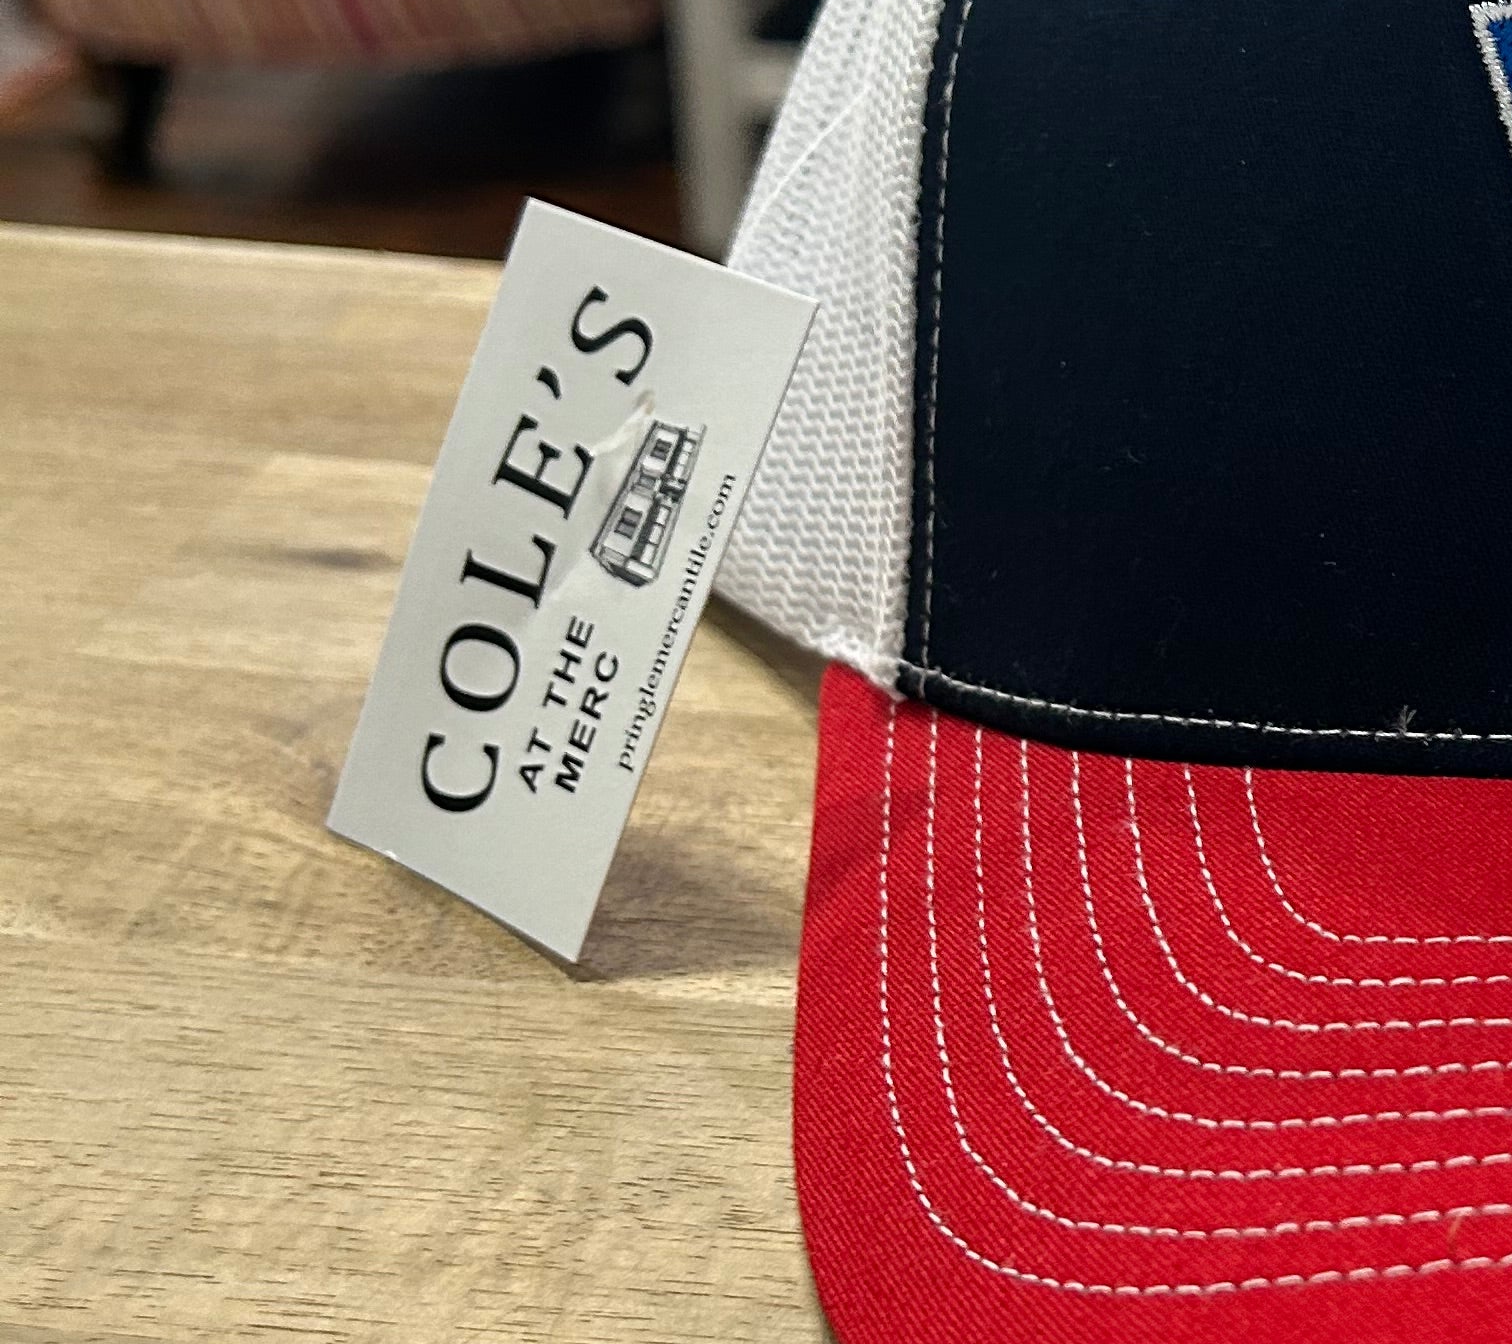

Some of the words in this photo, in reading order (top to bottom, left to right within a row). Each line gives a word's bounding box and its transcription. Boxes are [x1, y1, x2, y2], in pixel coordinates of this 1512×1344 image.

[421, 285, 654, 814] COLE'S
[618, 472, 737, 773] pringlemercantile.com
[518, 725, 557, 794] AT
[542, 614, 597, 712] THE
[555, 653, 621, 794] MERC
